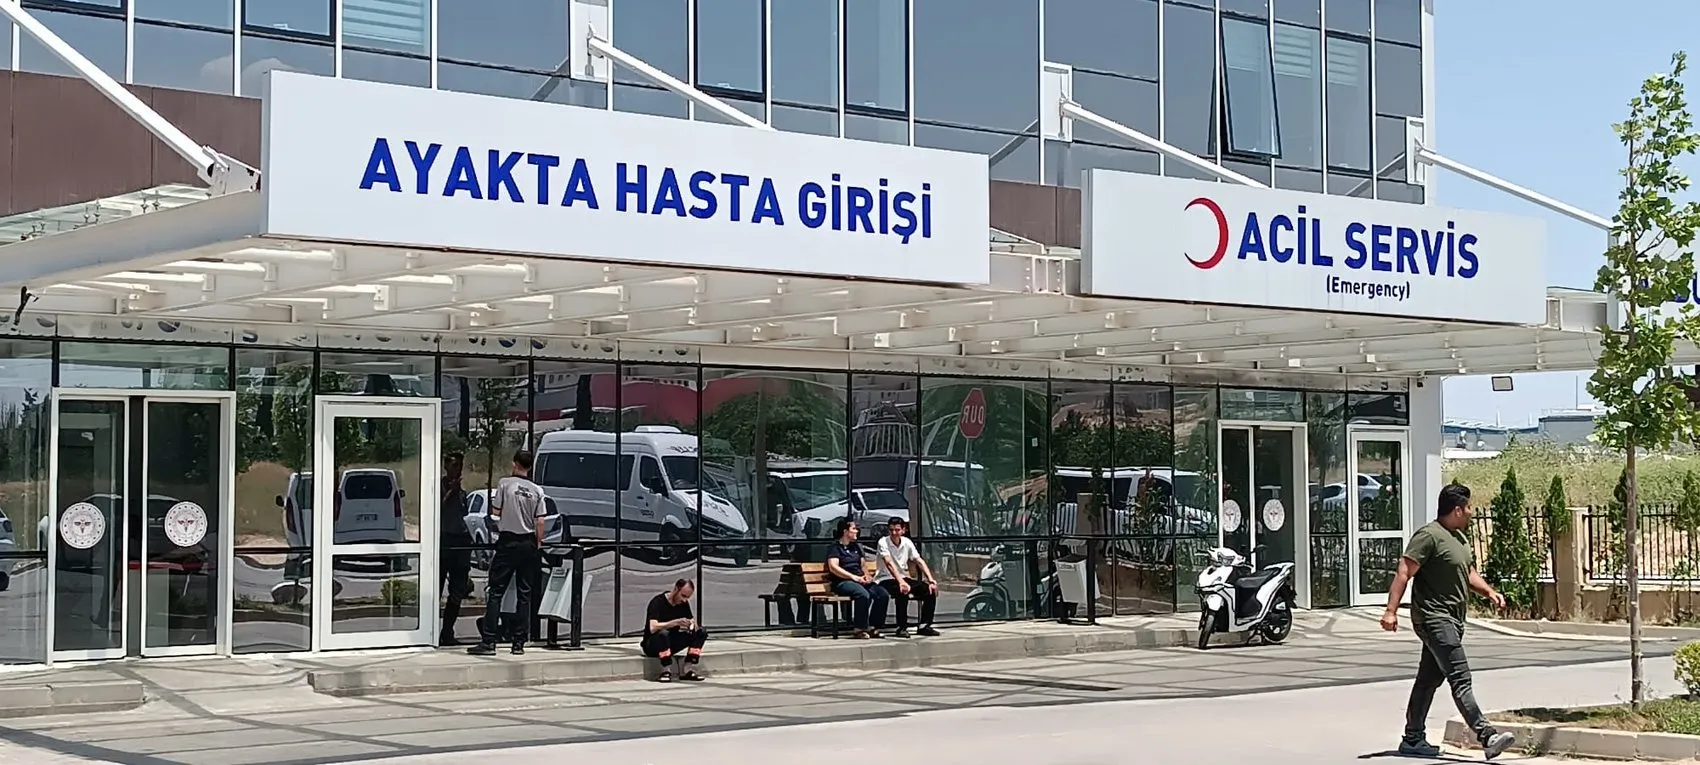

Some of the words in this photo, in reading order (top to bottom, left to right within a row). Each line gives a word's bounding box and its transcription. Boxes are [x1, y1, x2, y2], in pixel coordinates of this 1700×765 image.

[359, 137, 600, 210] AYAKTA
[615, 162, 785, 226] HASTA
[798, 173, 932, 245] GİRİŞİ
[1237, 205, 1334, 267] ACİL
[1344, 220, 1480, 279] SERVİS
[1326, 274, 1411, 300] (Emergency)
